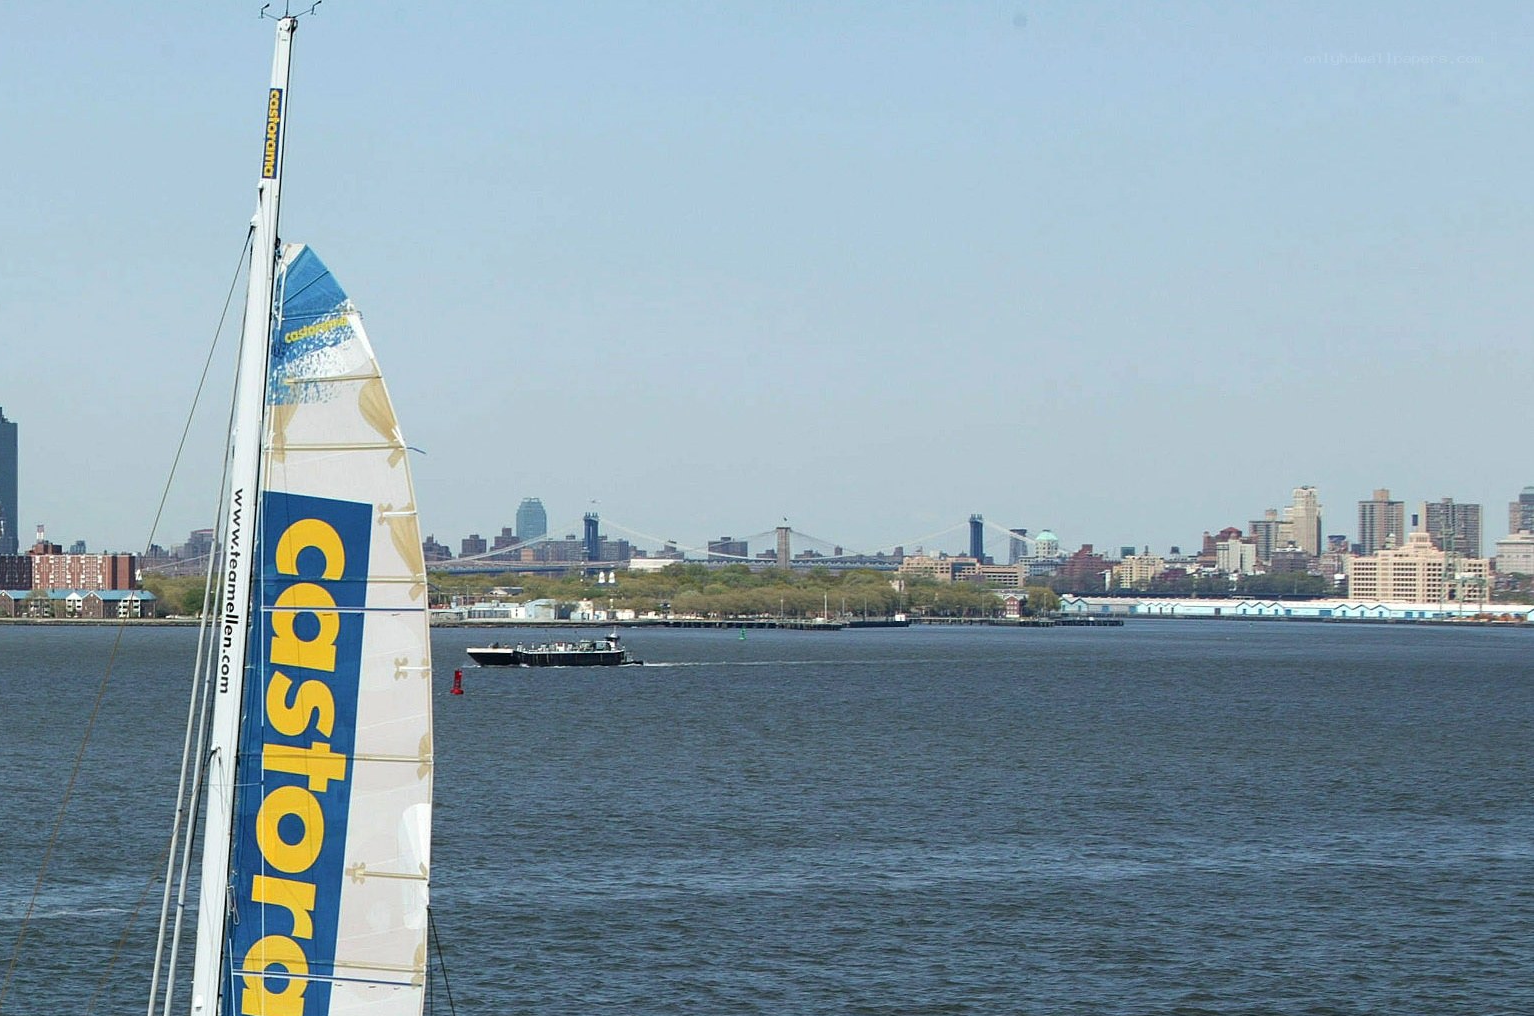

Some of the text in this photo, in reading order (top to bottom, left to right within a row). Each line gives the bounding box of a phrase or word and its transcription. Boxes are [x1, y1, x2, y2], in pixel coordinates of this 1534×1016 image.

[263, 90, 281, 177] castorama
[284, 315, 348, 343] castorama
[219, 488, 244, 694] www.teamellen.com
